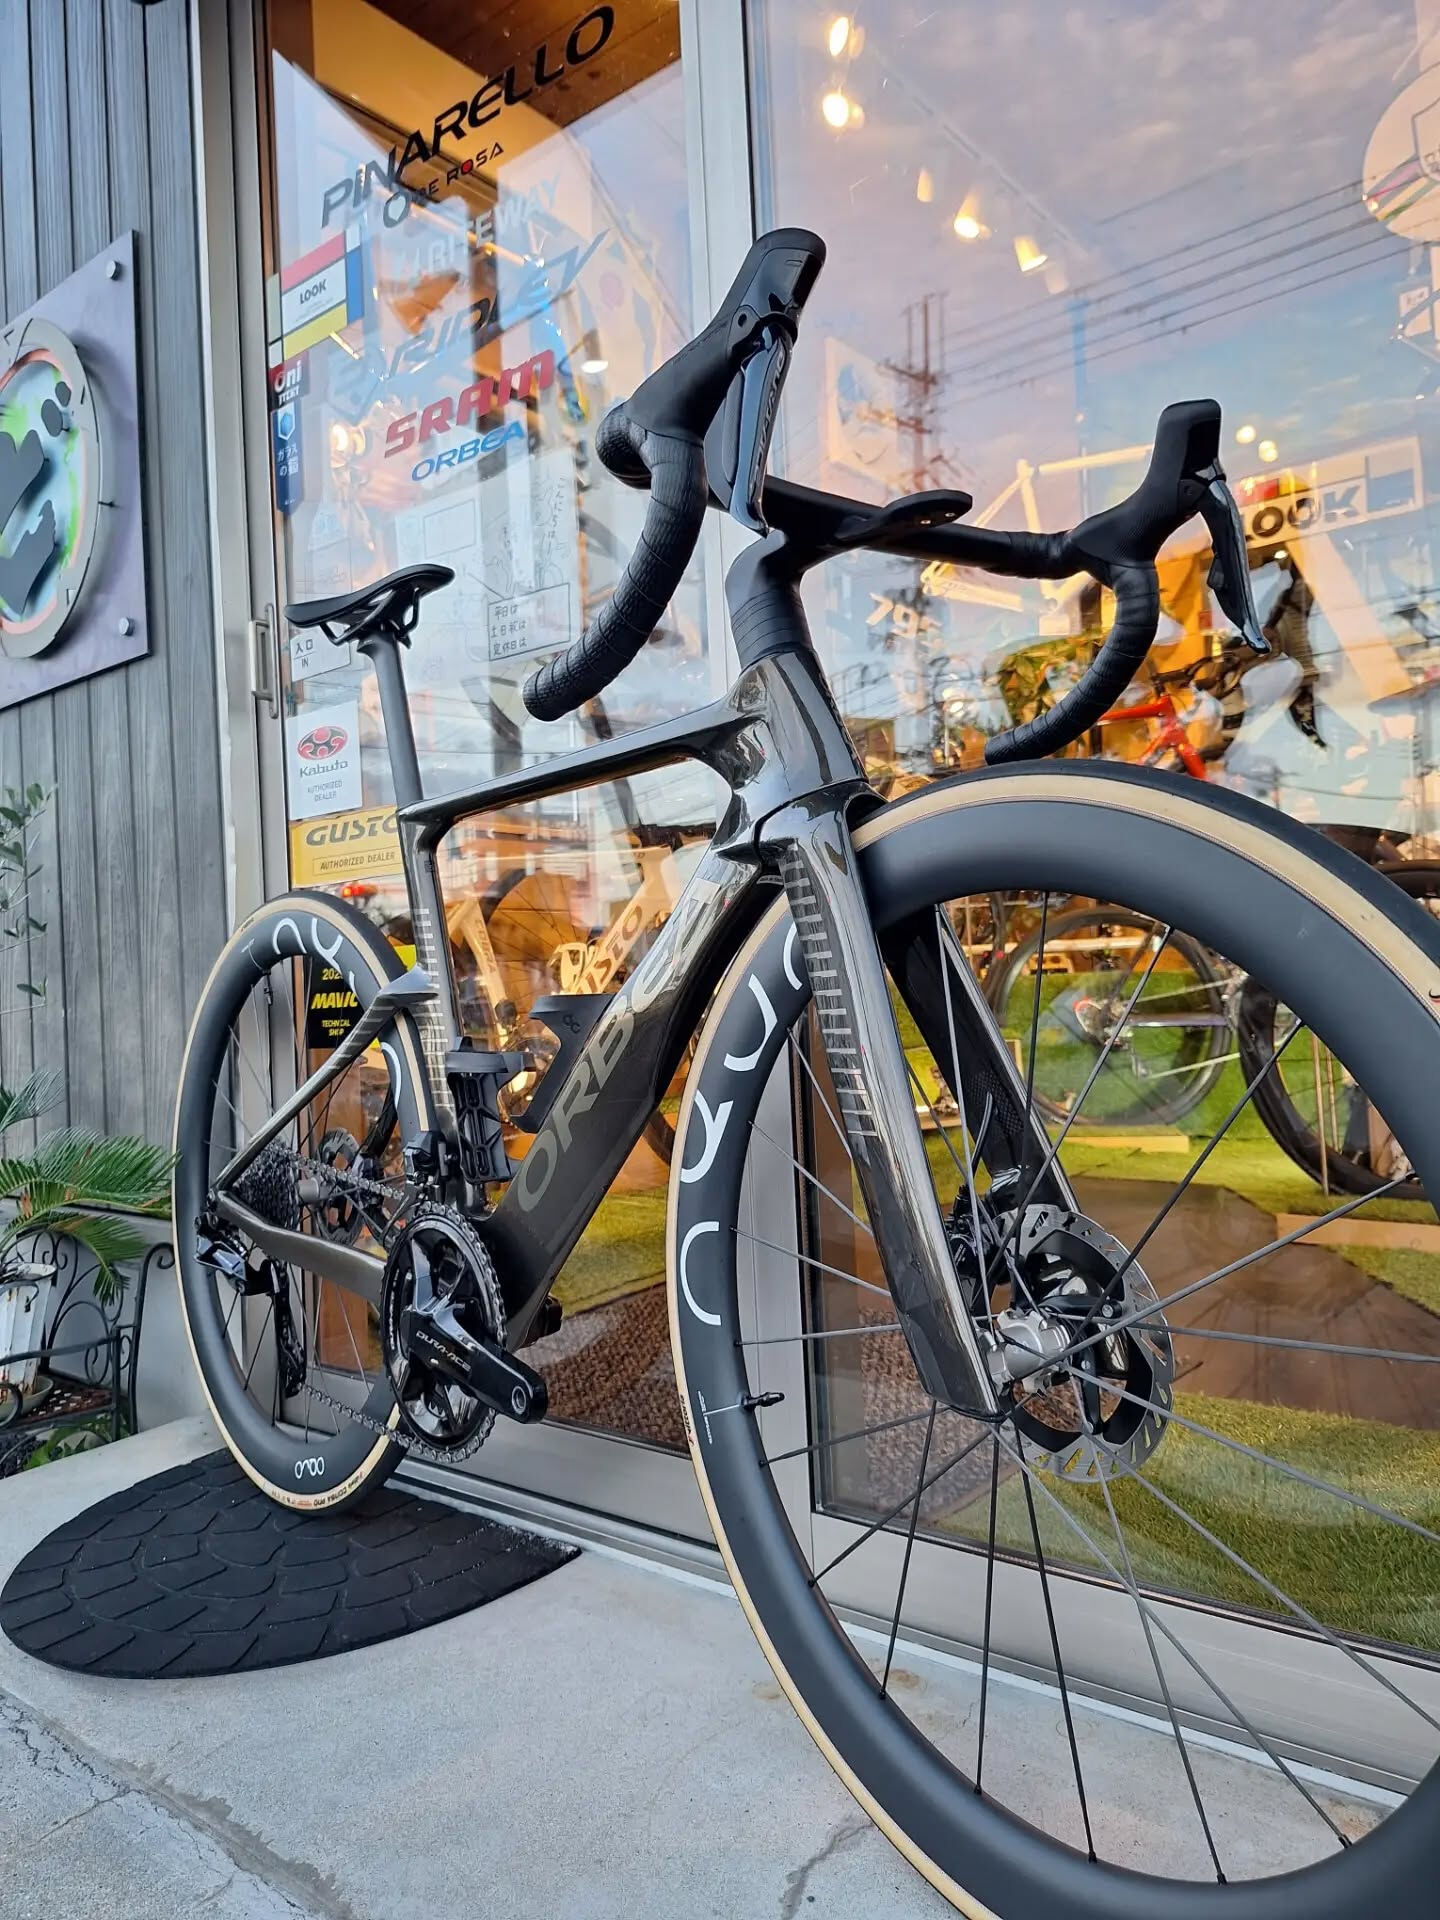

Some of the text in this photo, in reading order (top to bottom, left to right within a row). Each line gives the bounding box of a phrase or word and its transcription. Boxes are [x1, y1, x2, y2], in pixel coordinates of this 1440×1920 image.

[322, 5, 615, 229] PINARELLO
[446, 141, 505, 185] ROSA
[300, 278, 328, 305] LOOK
[384, 348, 555, 459] SRAM
[411, 421, 526, 482] ORBEA
[294, 638, 314, 654] 入口
[301, 657, 309, 668] IN
[299, 759, 349, 779] Kabuto
[307, 779, 343, 794] AUTHORIZED
[314, 791, 337, 802] DEALER
[320, 855, 365, 870] AUTHORIZED
[367, 851, 396, 864] DEALER
[322, 967, 344, 981] 202
[311, 991, 358, 1010] MAVIC
[517, 878, 721, 1213] ORBEA
[415, 1329, 472, 1373] DURA-ACE
